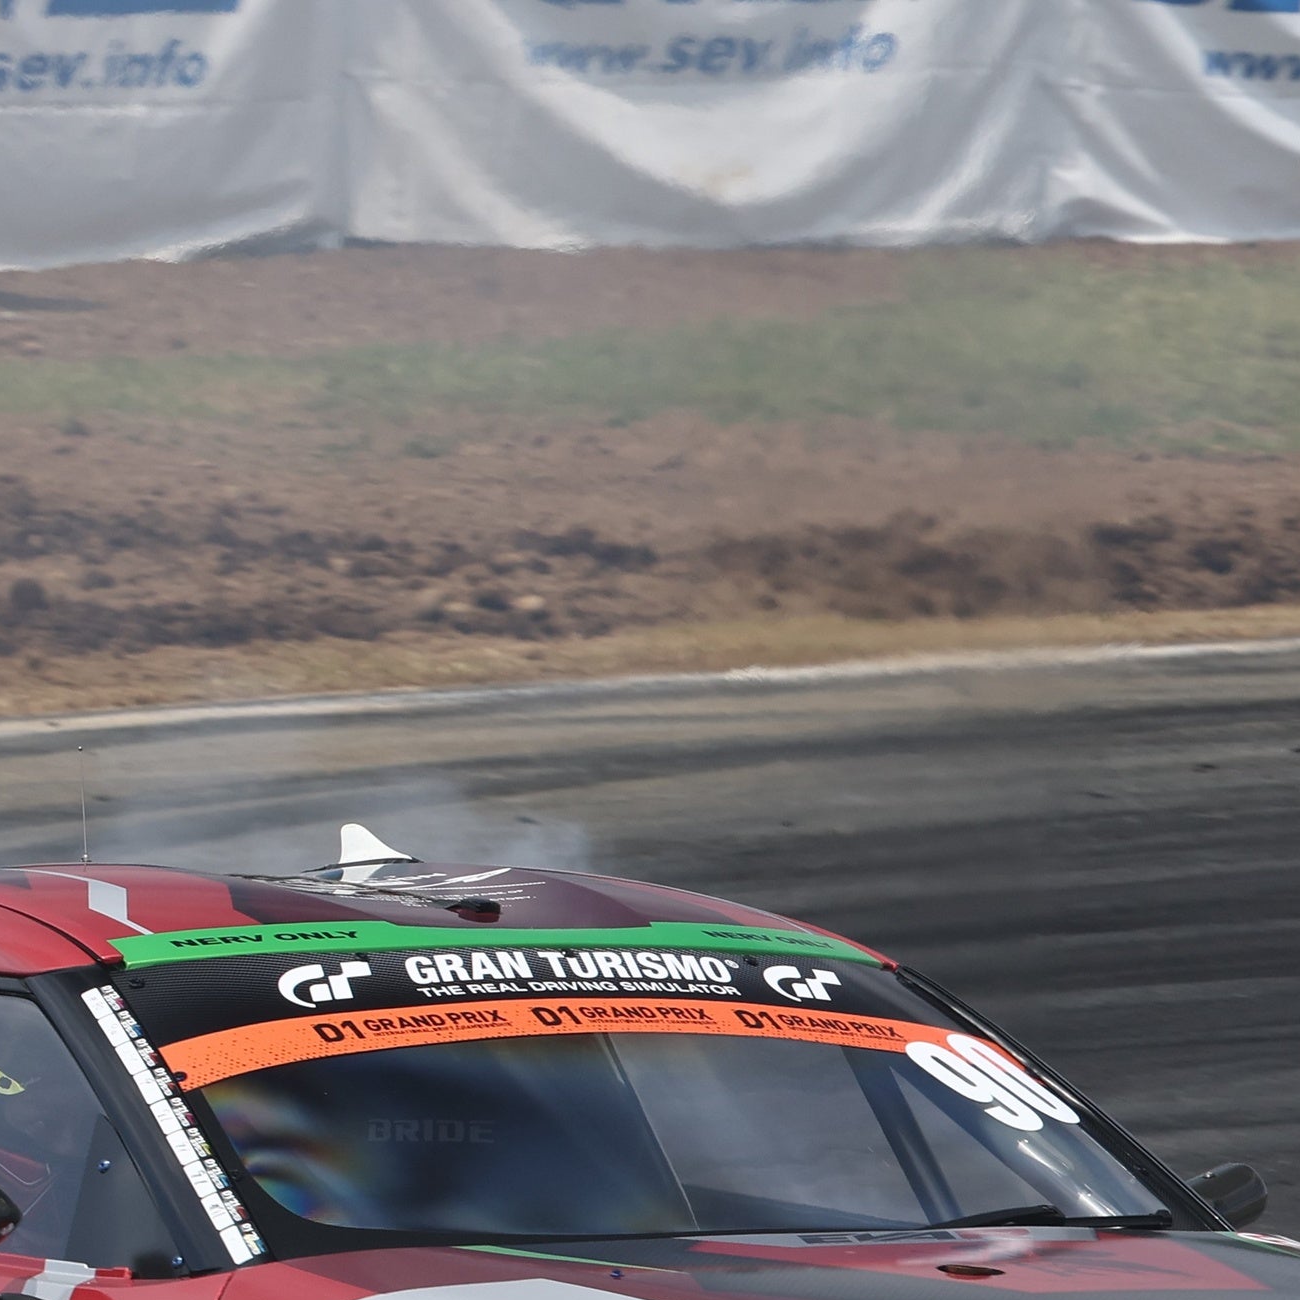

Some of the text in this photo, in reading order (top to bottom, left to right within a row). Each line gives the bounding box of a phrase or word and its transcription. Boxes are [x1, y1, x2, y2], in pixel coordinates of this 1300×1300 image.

[170, 930, 358, 949] NERV ONLY
[404, 951, 532, 985] GRAN
[417, 981, 742, 999] THE REAL DRIVING SIMULATOR
[312, 1009, 508, 1044] D1 GRAND PRIX
[532, 1006, 714, 1027] D1 GRAND PRIX
[734, 1010, 905, 1039] D1 GRAND PRIX
[905, 1033, 1081, 1131] 90
[366, 1118, 495, 1144] BRIDE
